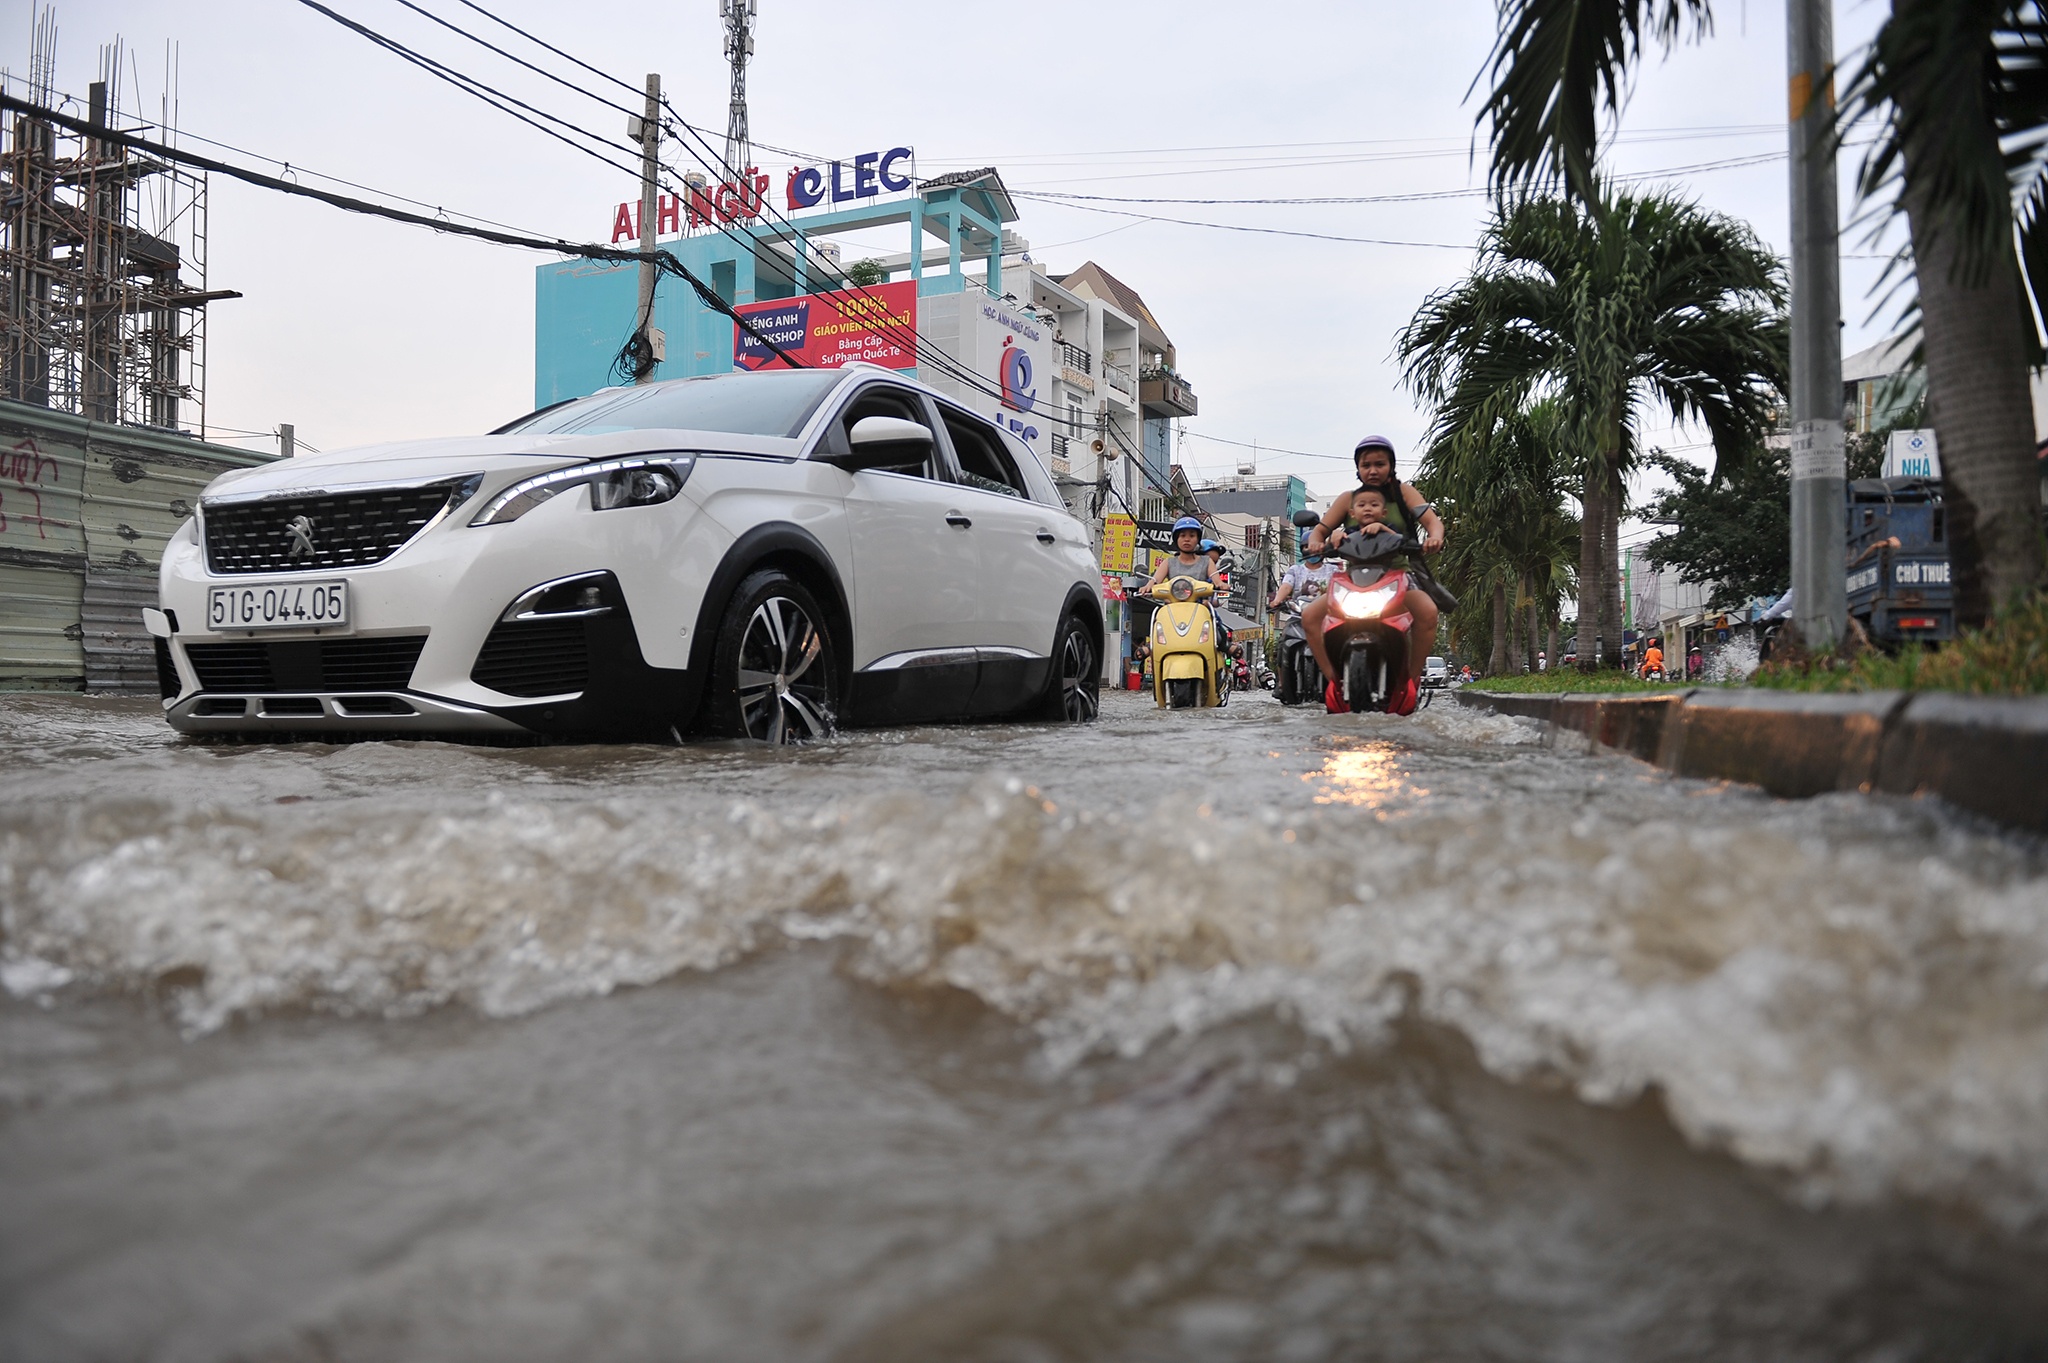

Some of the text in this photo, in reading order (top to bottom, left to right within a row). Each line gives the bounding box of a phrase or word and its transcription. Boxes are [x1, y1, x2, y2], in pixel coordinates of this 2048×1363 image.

[691, 166, 770, 229] NGỮ
[835, 294, 888, 318] 100%
[775, 313, 798, 327] ANH
[813, 322, 838, 337] GIÁO
[887, 310, 911, 327] NGỮ
[996, 312, 1010, 326] ANH
[743, 329, 804, 347] WORKSHOP
[864, 334, 883, 347] Cấp
[821, 354, 834, 364] Sư
[863, 346, 888, 360] Quốc
[889, 344, 901, 356] Tế
[1902, 454, 1931, 476] NHÀ
[1921, 561, 1951, 583] THUÊ
[212, 585, 342, 624] 51G-044.05
